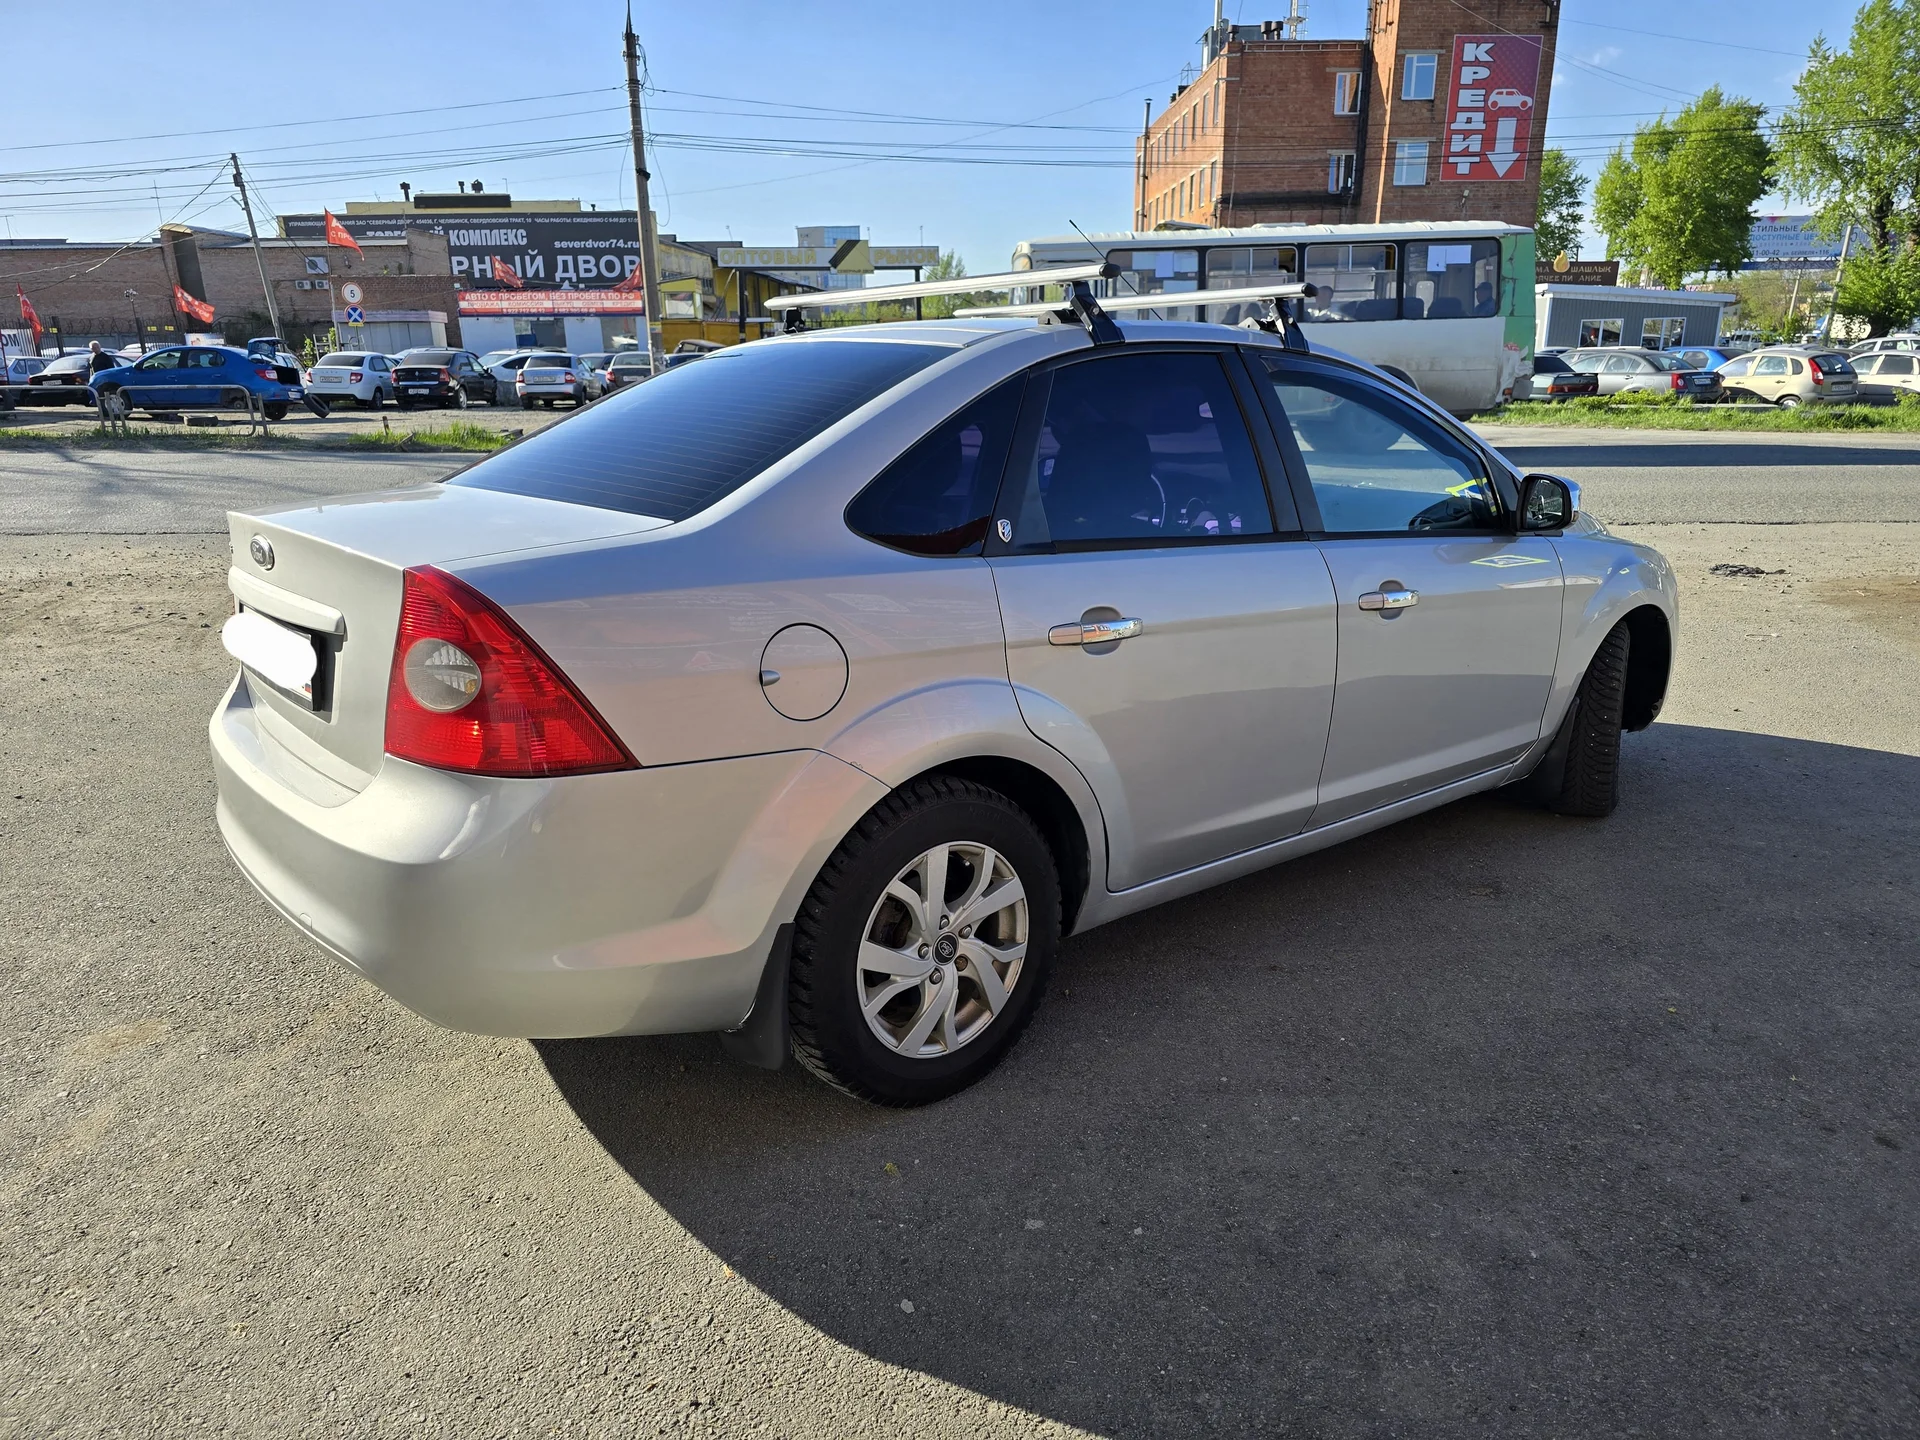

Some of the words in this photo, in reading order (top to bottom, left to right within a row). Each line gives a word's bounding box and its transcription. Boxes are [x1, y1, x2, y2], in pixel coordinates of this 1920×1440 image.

[1448, 43, 1495, 175] КРЕДИТ
[1750, 225, 1798, 233] СТИЛЬНЫЕ
[449, 229, 527, 246] КОМПЛЕКС
[554, 239, 639, 249] severdvor74.ru
[719, 248, 817, 265] ОПТОВЫЙ
[873, 249, 938, 265] РЫНОК
[555, 255, 640, 282] ДВОР
[350, 290, 355, 299] 5
[465, 292, 488, 301] АВТО
[490, 292, 496, 300] С
[550, 292, 566, 300] БЕЗ
[568, 292, 607, 300] ПРОБЕГА
[608, 292, 621, 300] ПО
[622, 292, 635, 300] РФ
